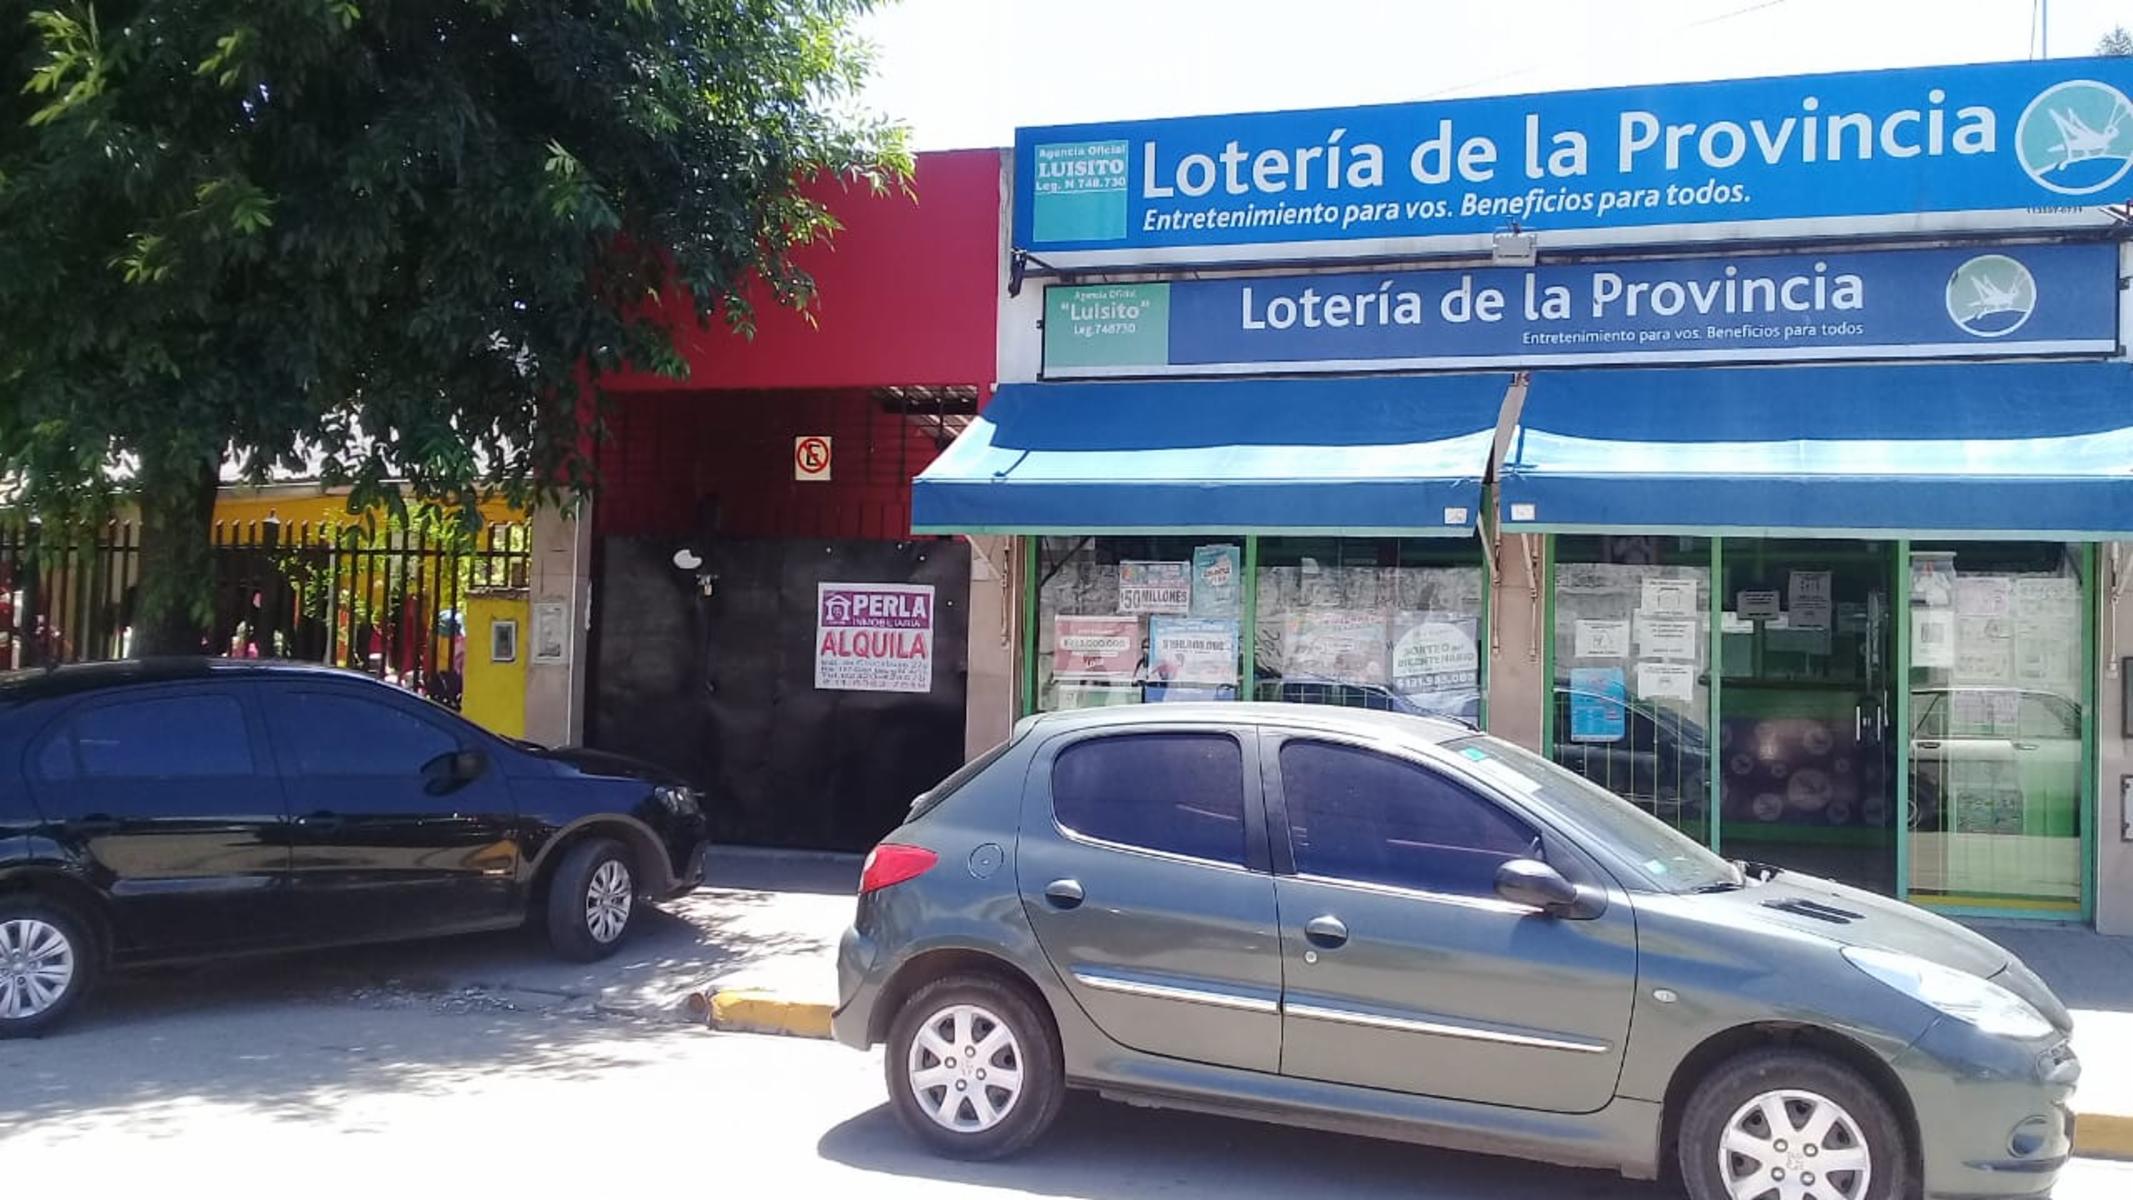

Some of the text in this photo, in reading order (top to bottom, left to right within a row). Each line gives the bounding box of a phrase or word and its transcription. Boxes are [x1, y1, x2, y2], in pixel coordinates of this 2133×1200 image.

[1039, 149, 1085, 160] Agencia
[1143, 89, 1996, 198] Lotería de la Provincia
[1039, 159, 1124, 177] LUISITO
[1036, 181, 1061, 192] Leg.
[1143, 180, 1751, 232] Entretenimiento para vos. Beneficios para todos.
[1242, 262, 1864, 330] Lotería de la Provincia
[1522, 329, 1635, 344] Entretenimiento
[1639, 332, 1671, 343] para
[1707, 324, 1780, 338] Beneficios
[1784, 326, 1816, 340] para
[1822, 322, 1863, 335] todos
[853, 594, 927, 618] PERLA
[1141, 591, 1188, 603] MILLONES
[820, 630, 928, 660] ALQUILA
